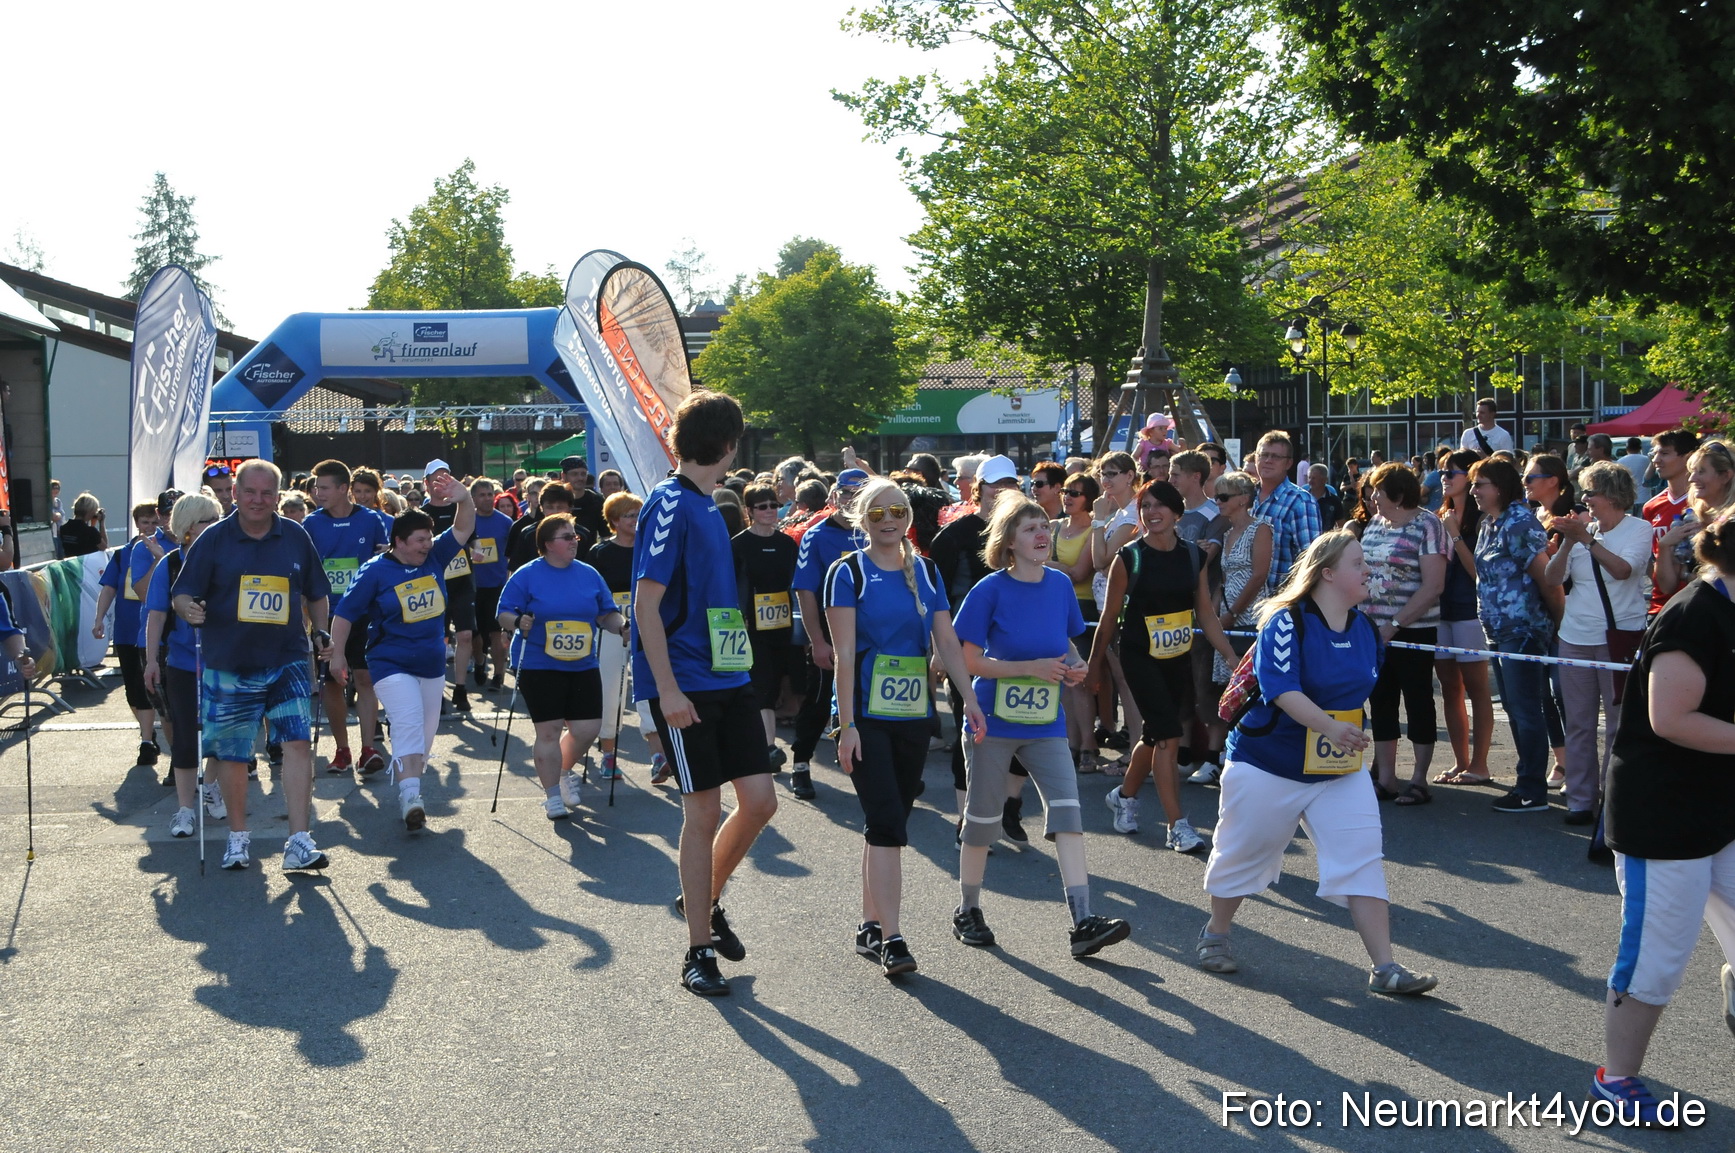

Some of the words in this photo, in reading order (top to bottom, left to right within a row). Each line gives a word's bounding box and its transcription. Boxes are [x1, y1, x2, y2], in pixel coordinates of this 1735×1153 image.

[151, 293, 187, 414] Fischer
[402, 342, 478, 358] firmenlauf
[168, 316, 193, 412] AUTOMOBILE
[253, 369, 296, 379] Fischer
[327, 570, 353, 585] 681
[247, 591, 283, 612] 700
[407, 590, 435, 612] 647
[757, 604, 790, 621] 1079
[552, 634, 585, 651] 635
[718, 630, 747, 655] 712
[1152, 627, 1192, 649] 1098
[880, 677, 922, 702] 620
[1005, 685, 1050, 710] 643
